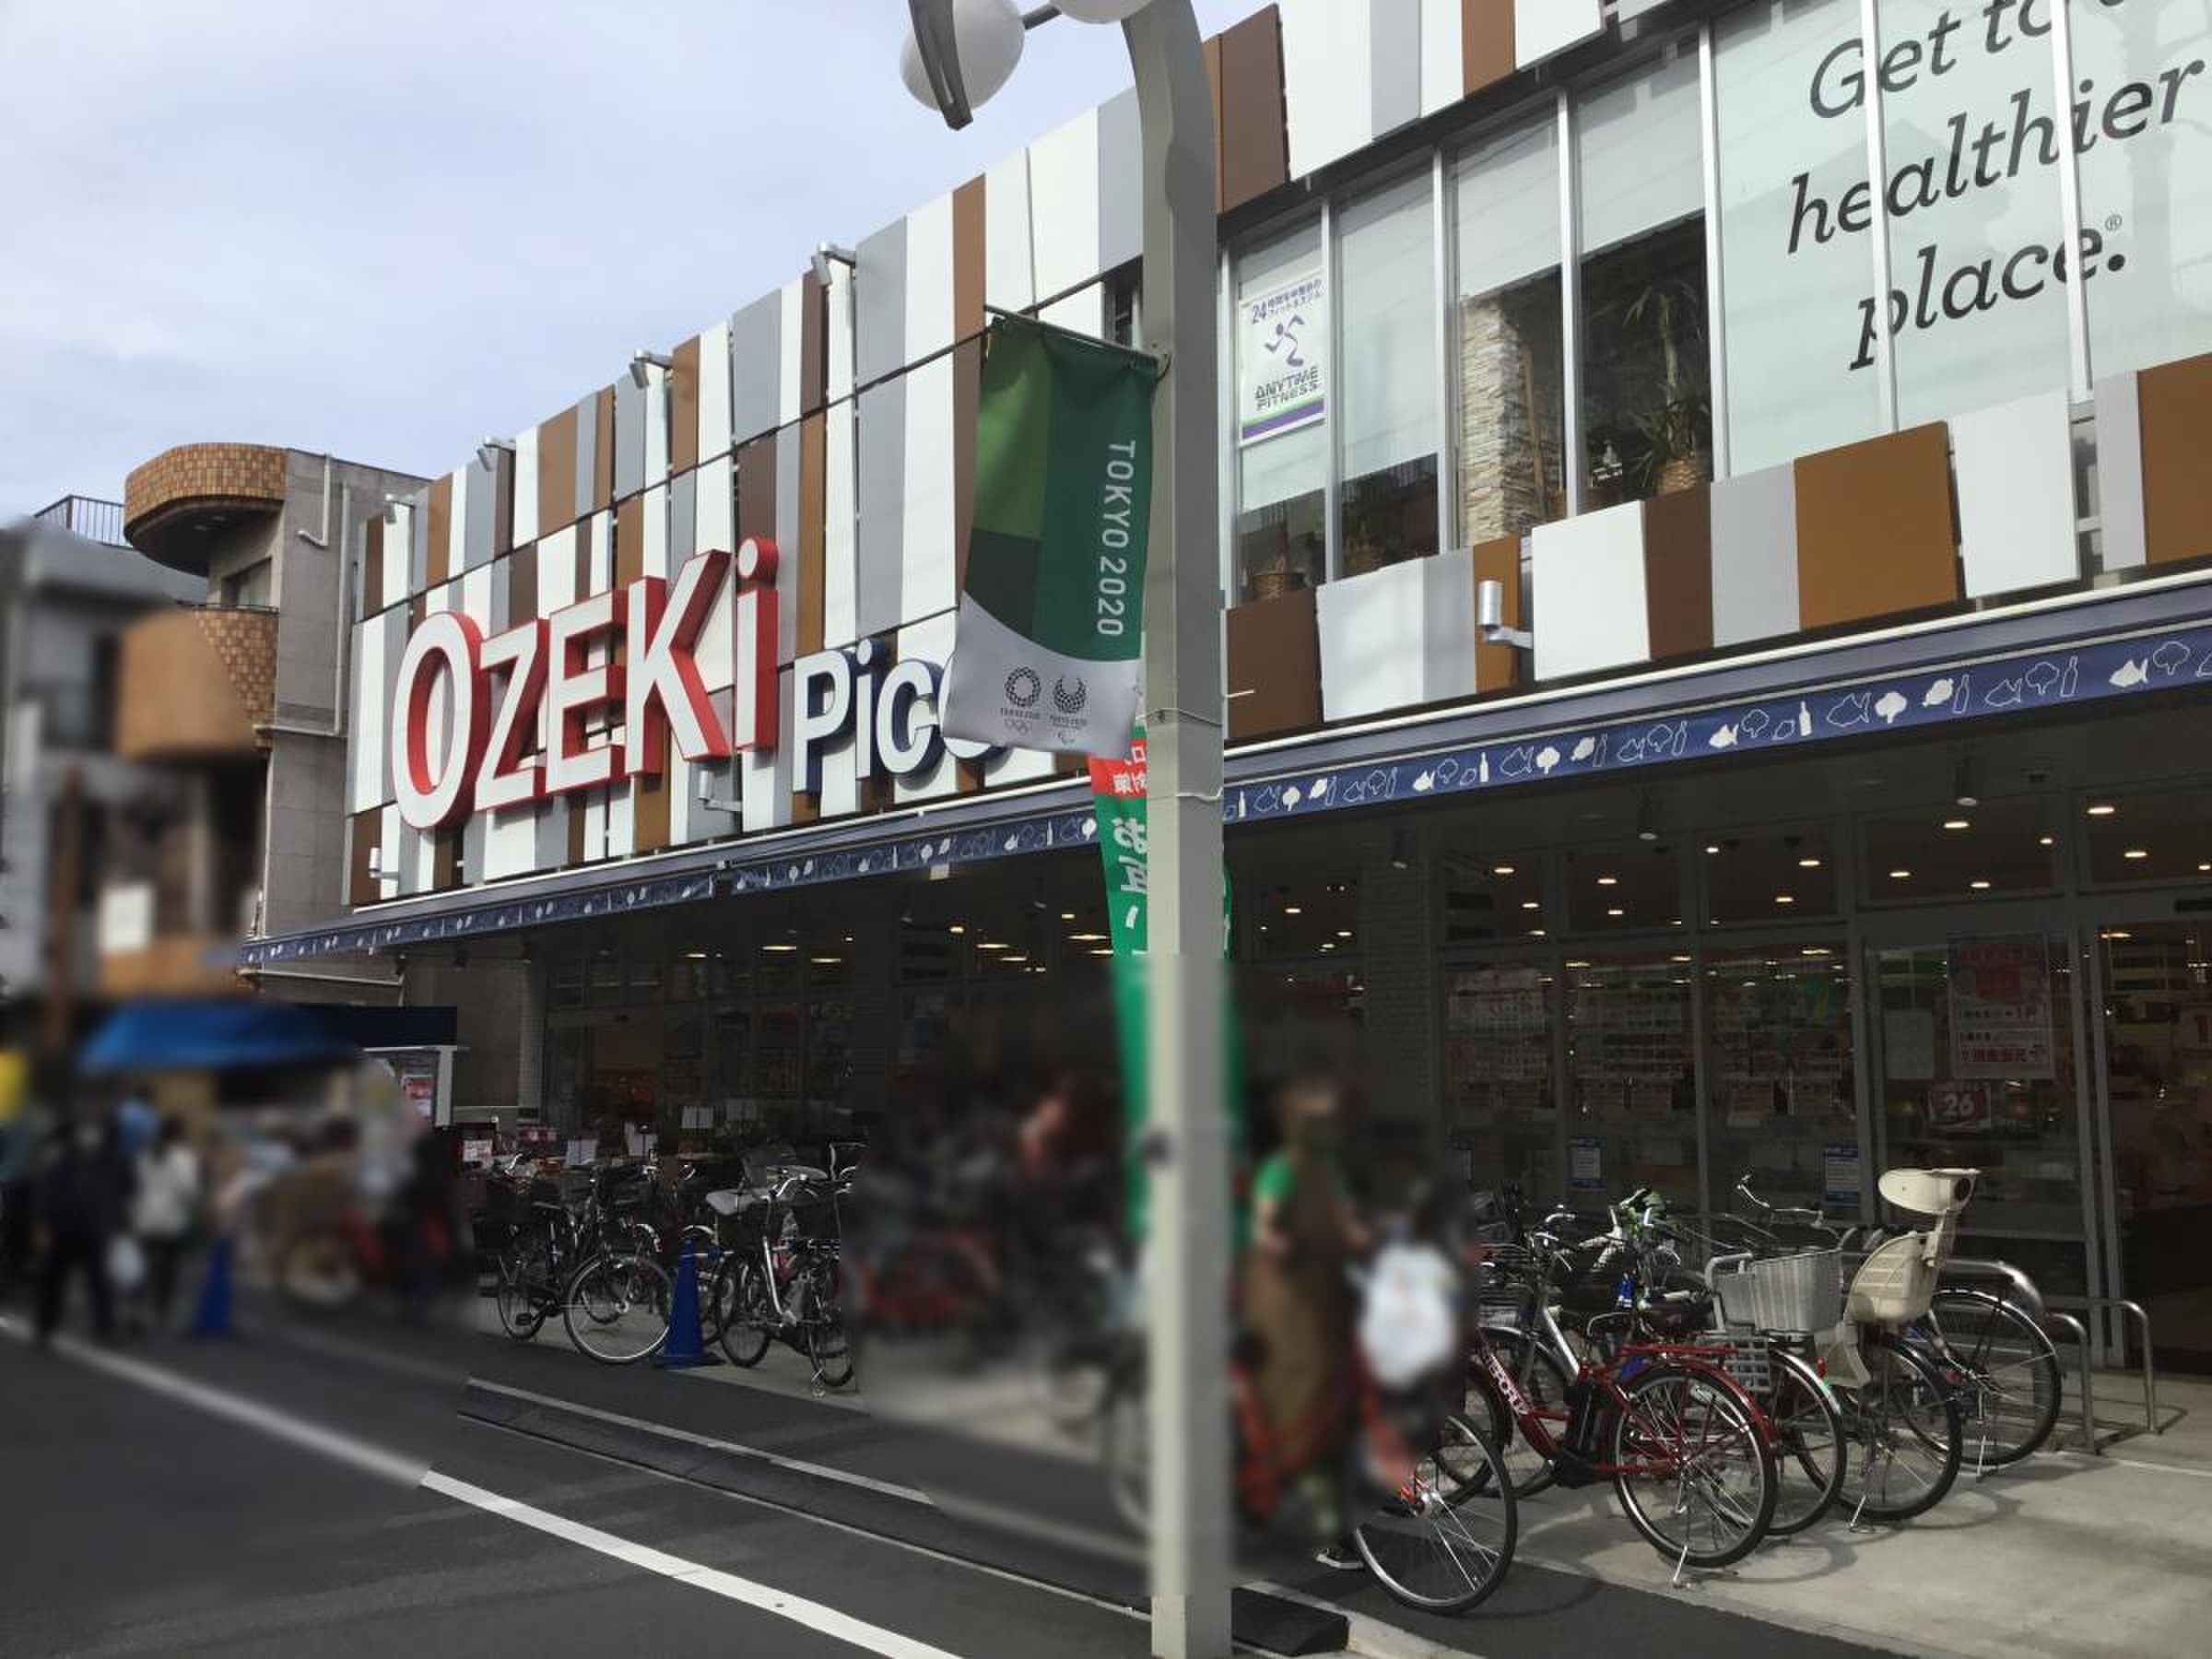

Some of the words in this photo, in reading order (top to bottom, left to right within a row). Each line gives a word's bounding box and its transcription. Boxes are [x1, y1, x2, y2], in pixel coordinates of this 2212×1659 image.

[1810, 11, 1961, 118] Get
[1788, 59, 2206, 254] healthier
[1849, 224, 2126, 371] place.
[1254, 366, 1320, 400] ANYTIME
[1255, 381, 1319, 412] FITNESS
[1101, 440, 1136, 549] TOKYO
[1097, 556, 1128, 638] 2020
[792, 636, 1015, 794] Pic
